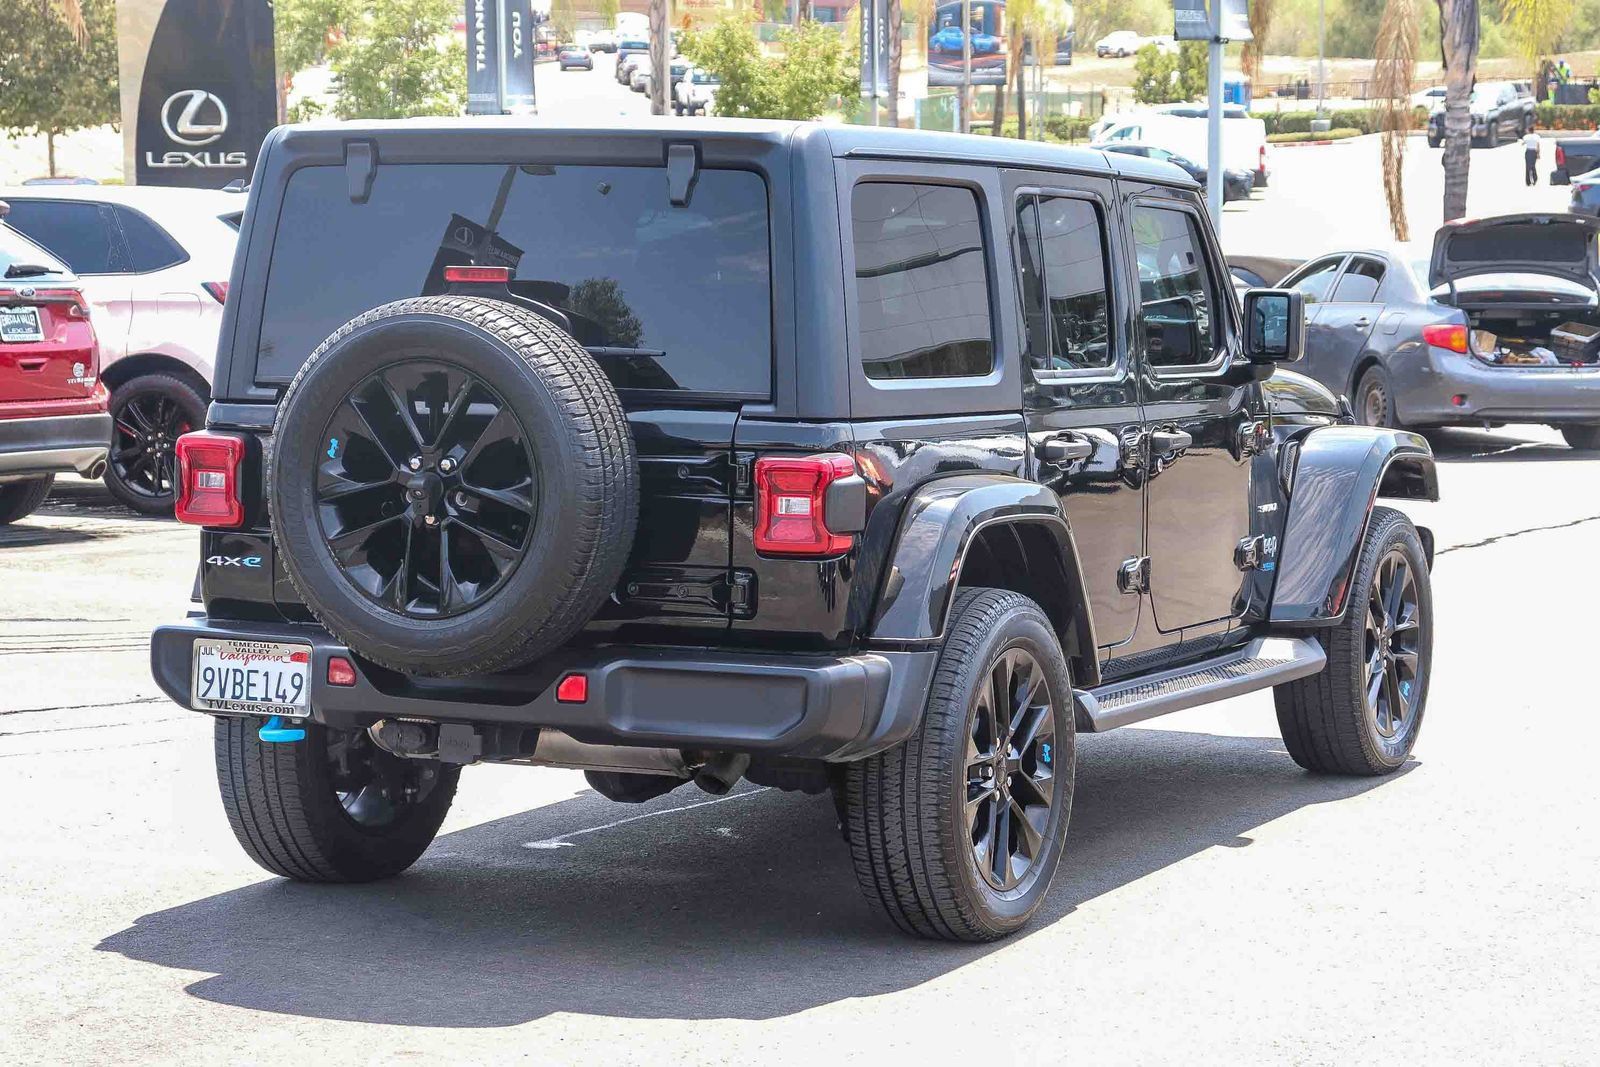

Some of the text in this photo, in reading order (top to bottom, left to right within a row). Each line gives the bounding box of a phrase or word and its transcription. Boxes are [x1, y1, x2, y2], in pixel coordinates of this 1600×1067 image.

[475, 0, 486, 73] THANK
[512, 11, 522, 59] YOU
[145, 151, 248, 168] LEXUS
[1263, 535, 1277, 557] eep
[201, 646, 215, 656] JUL
[227, 641, 280, 650] TEMECULA
[234, 647, 271, 655] VALLEY
[201, 666, 304, 704] 9VBE149
[207, 698, 295, 715] TVLexus.com
